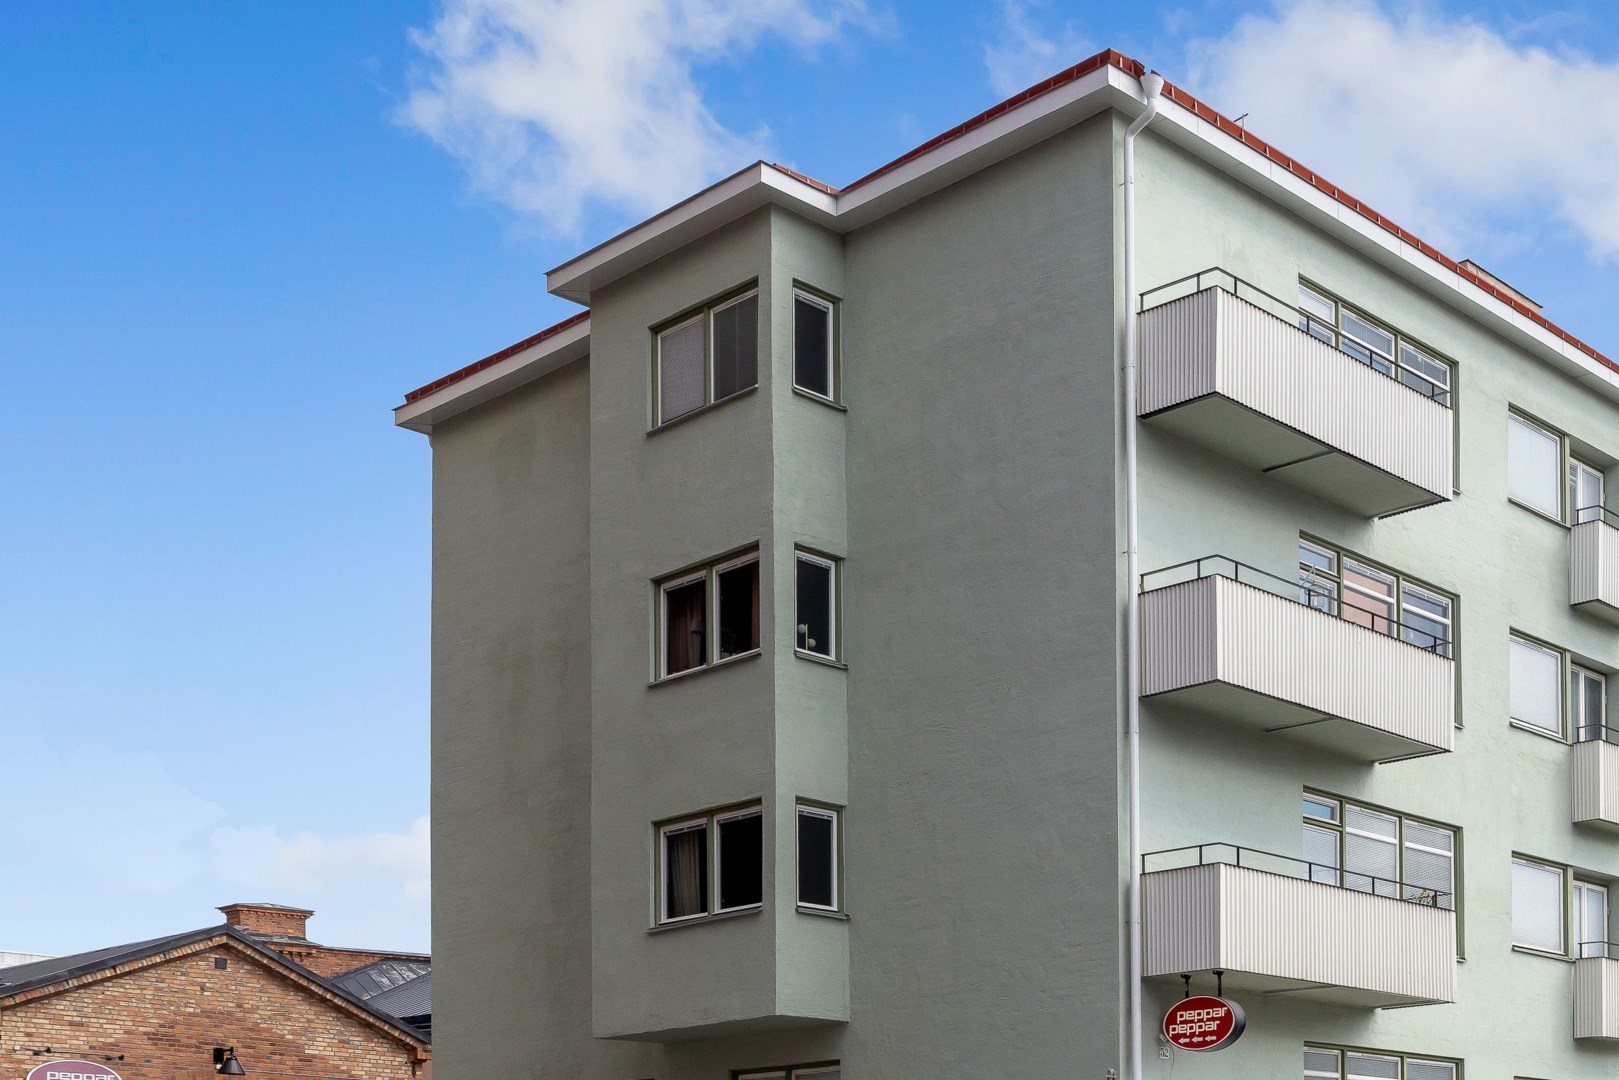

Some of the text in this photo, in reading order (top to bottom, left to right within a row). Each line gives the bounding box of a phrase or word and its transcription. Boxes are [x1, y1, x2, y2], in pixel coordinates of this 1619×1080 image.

[1177, 1007, 1228, 1024] peppar
[1169, 1020, 1220, 1037] peppar
[1160, 1047, 1169, 1058] 52
